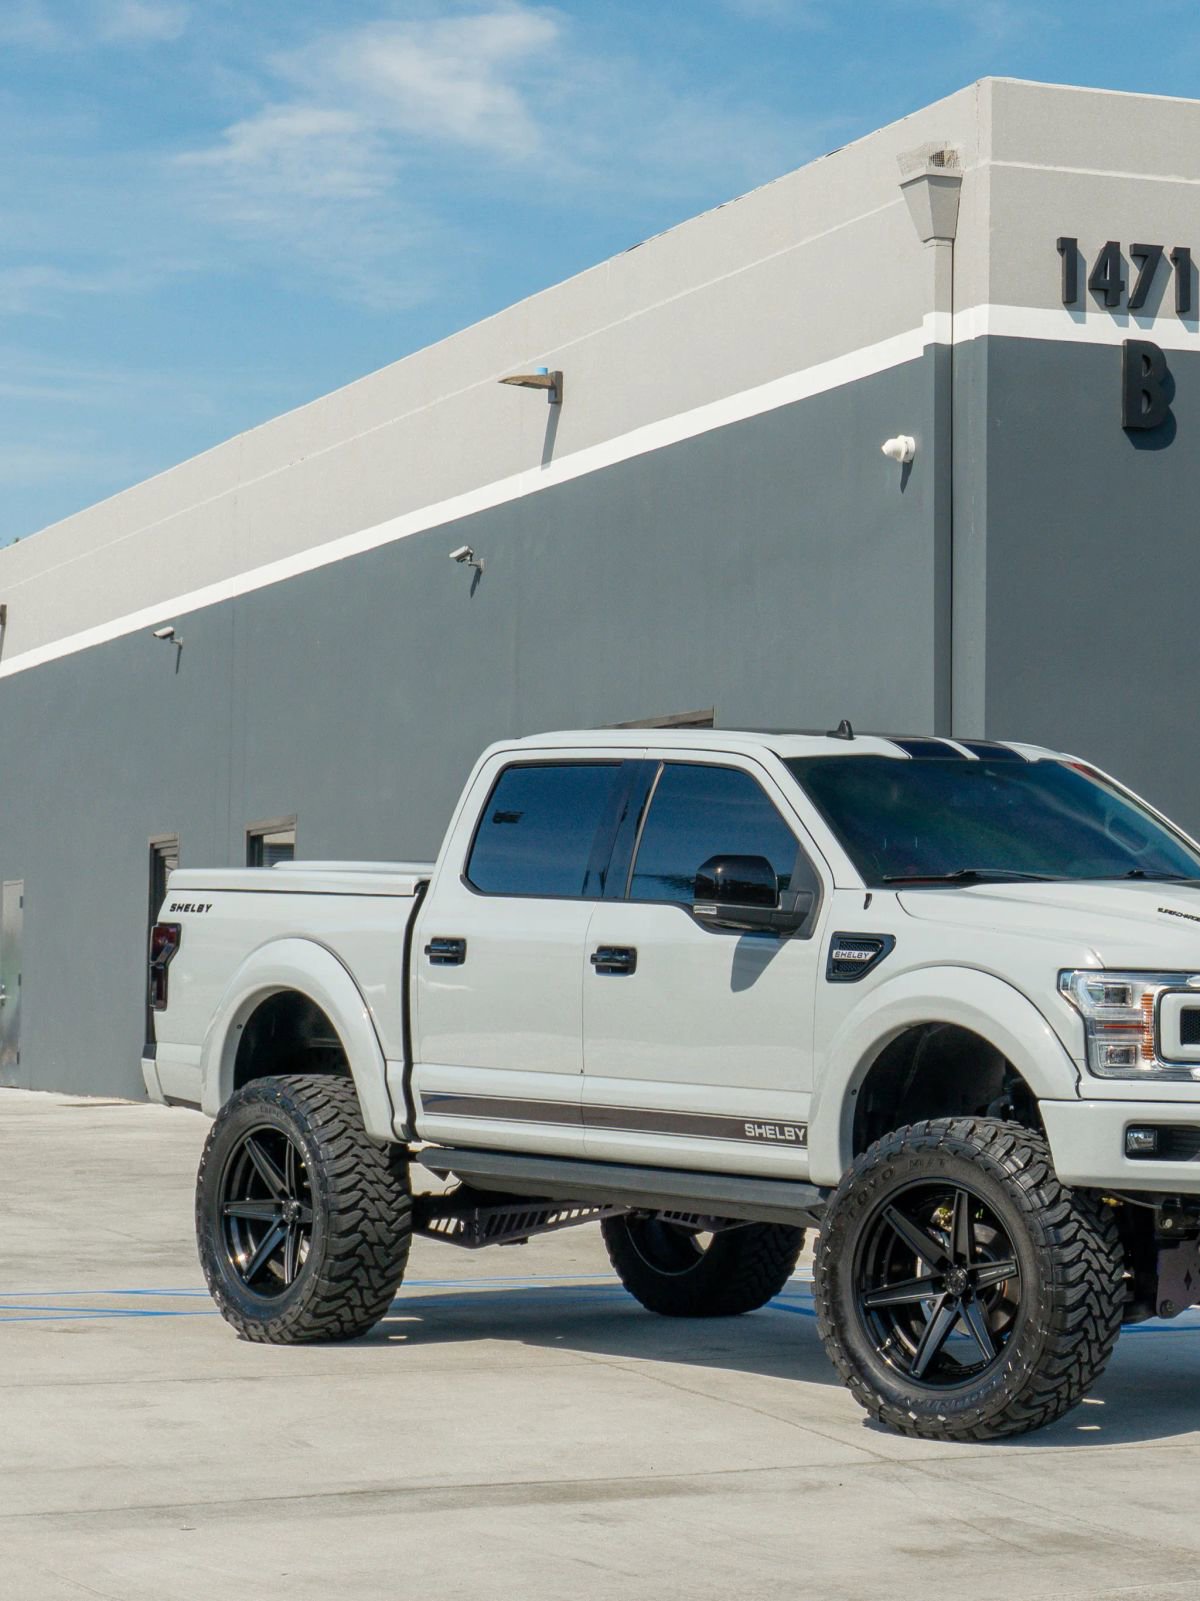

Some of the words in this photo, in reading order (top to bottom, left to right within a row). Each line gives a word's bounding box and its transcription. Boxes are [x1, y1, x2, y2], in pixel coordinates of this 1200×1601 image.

[1121, 338, 1169, 430] B
[168, 902, 213, 913] SHELBY
[834, 950, 870, 959] SHELBY
[744, 1122, 806, 1141] SHELBY
